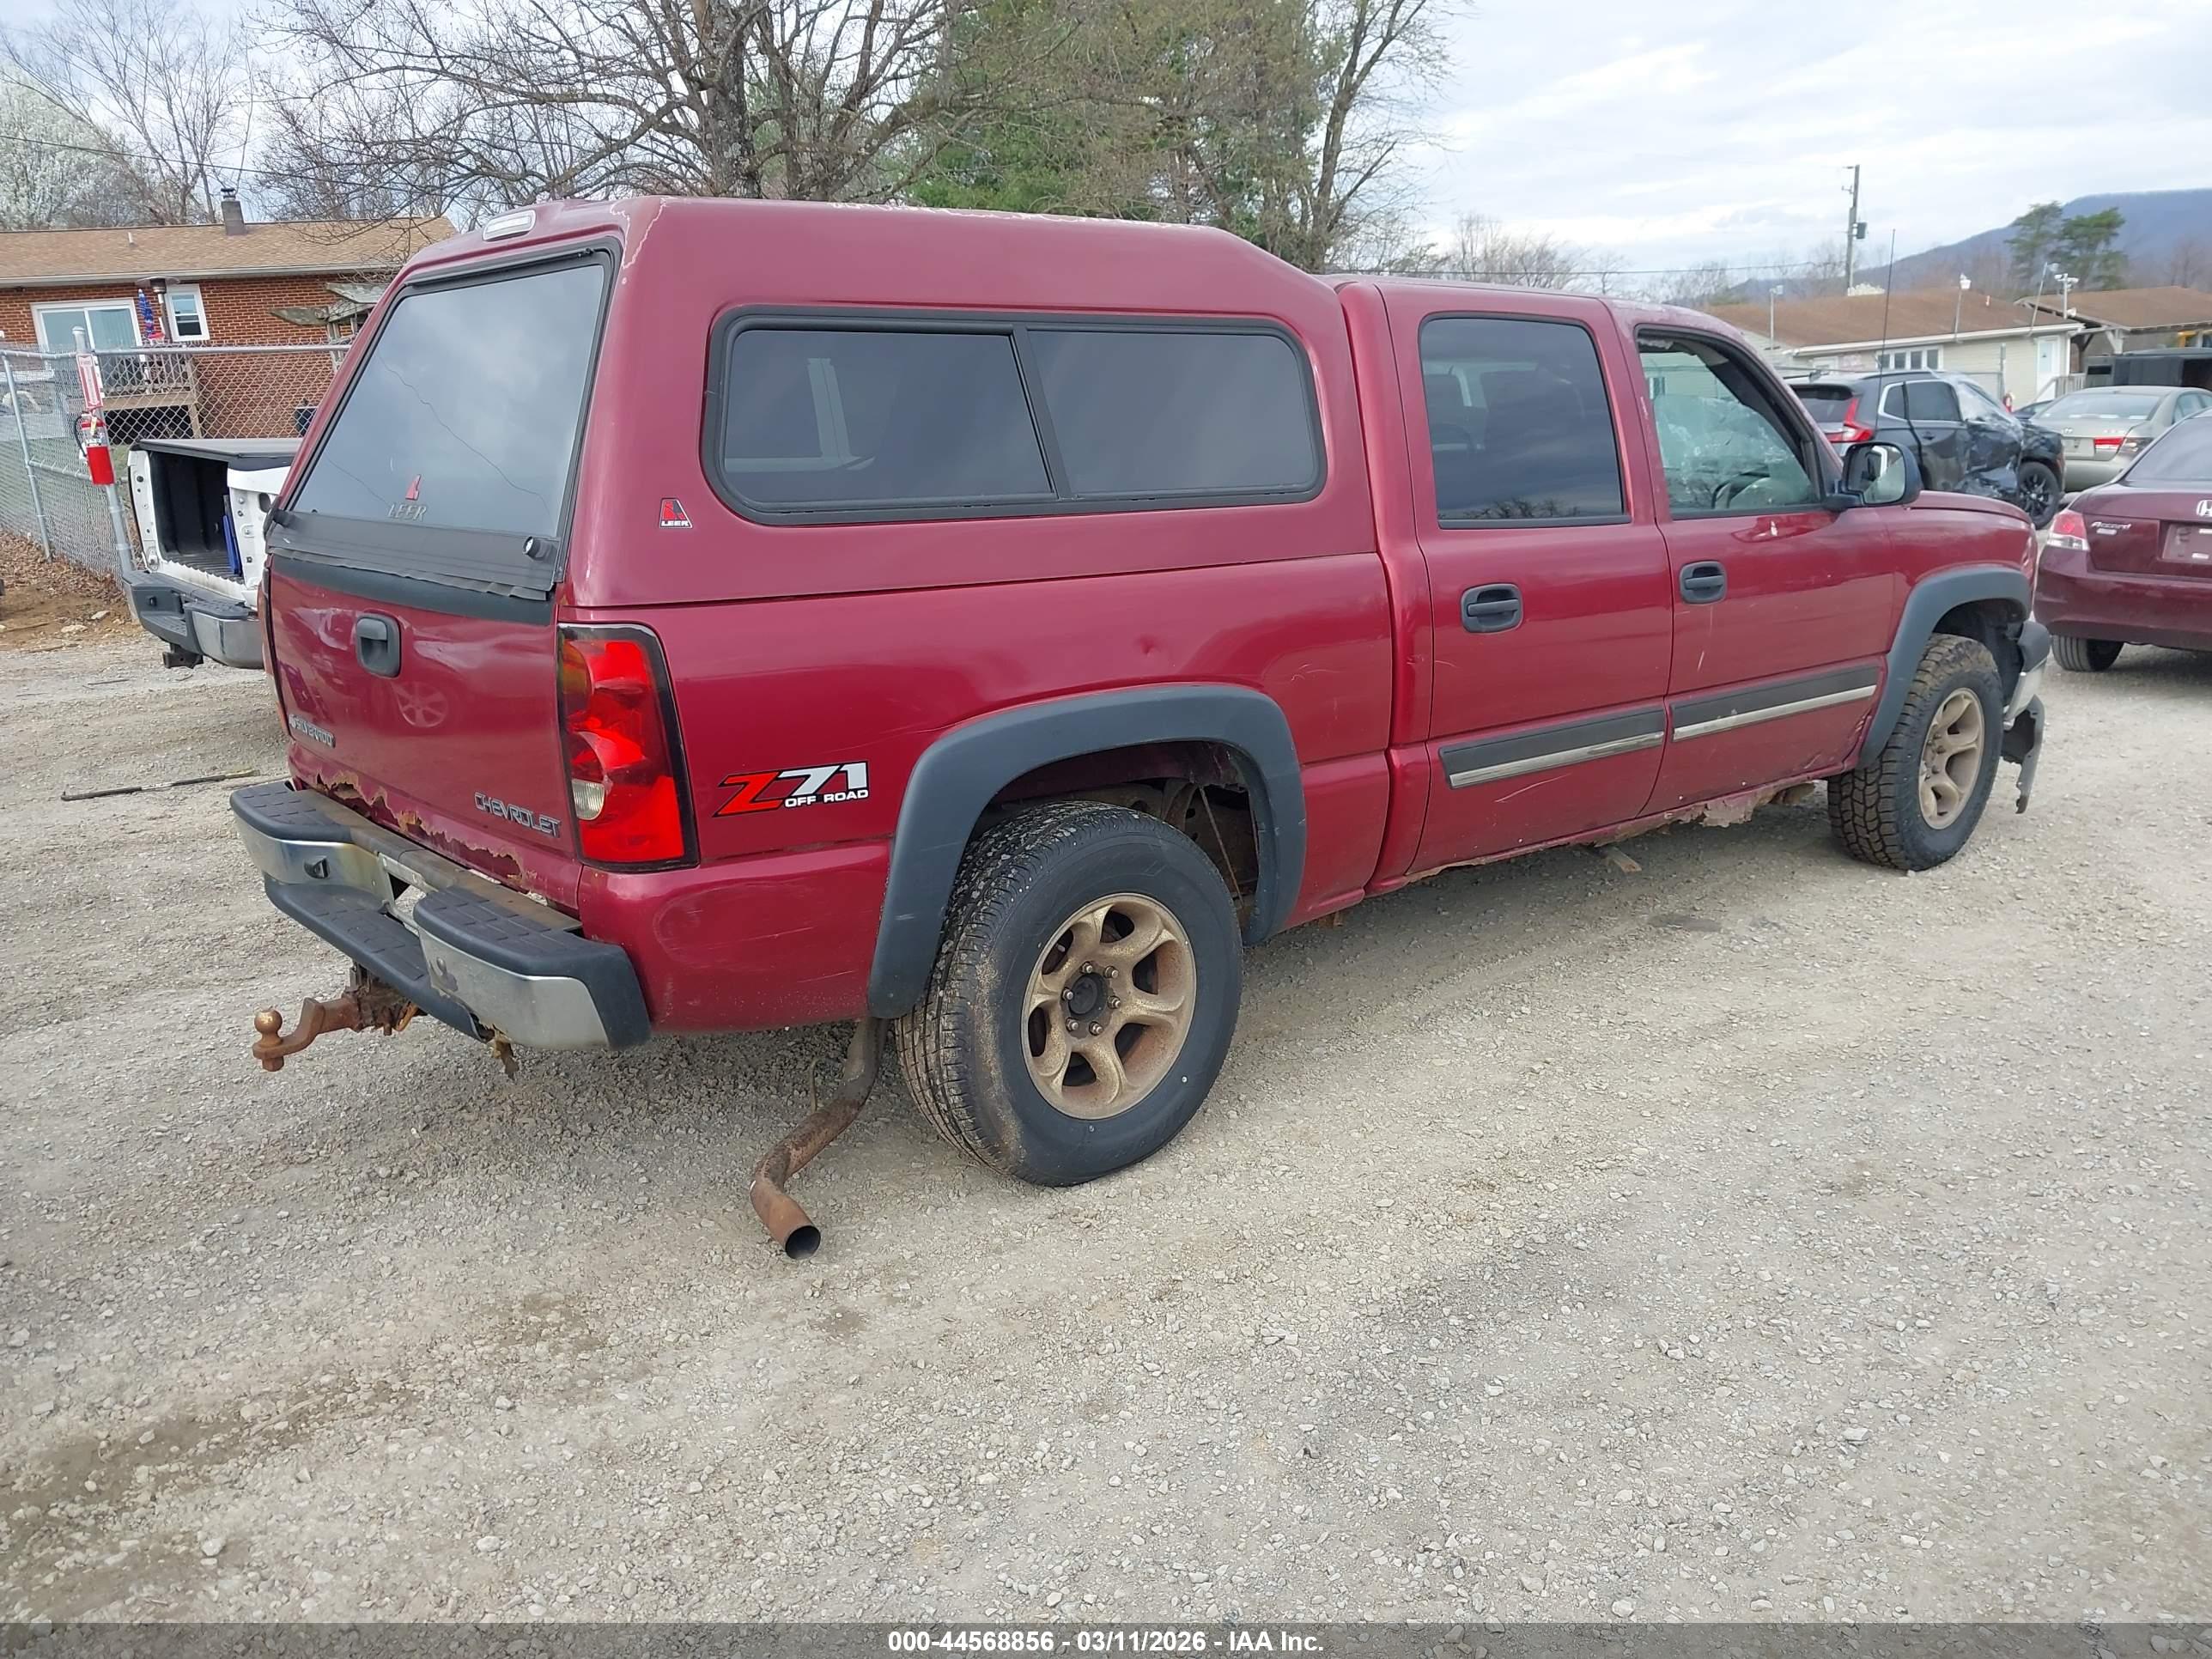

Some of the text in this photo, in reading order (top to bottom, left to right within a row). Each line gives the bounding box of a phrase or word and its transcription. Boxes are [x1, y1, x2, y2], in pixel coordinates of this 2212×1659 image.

[387, 503, 427, 522] LEER
[714, 761, 868, 817] Z71
[784, 788, 869, 808] OFF ROAD
[474, 791, 562, 838] CHEVROLET
